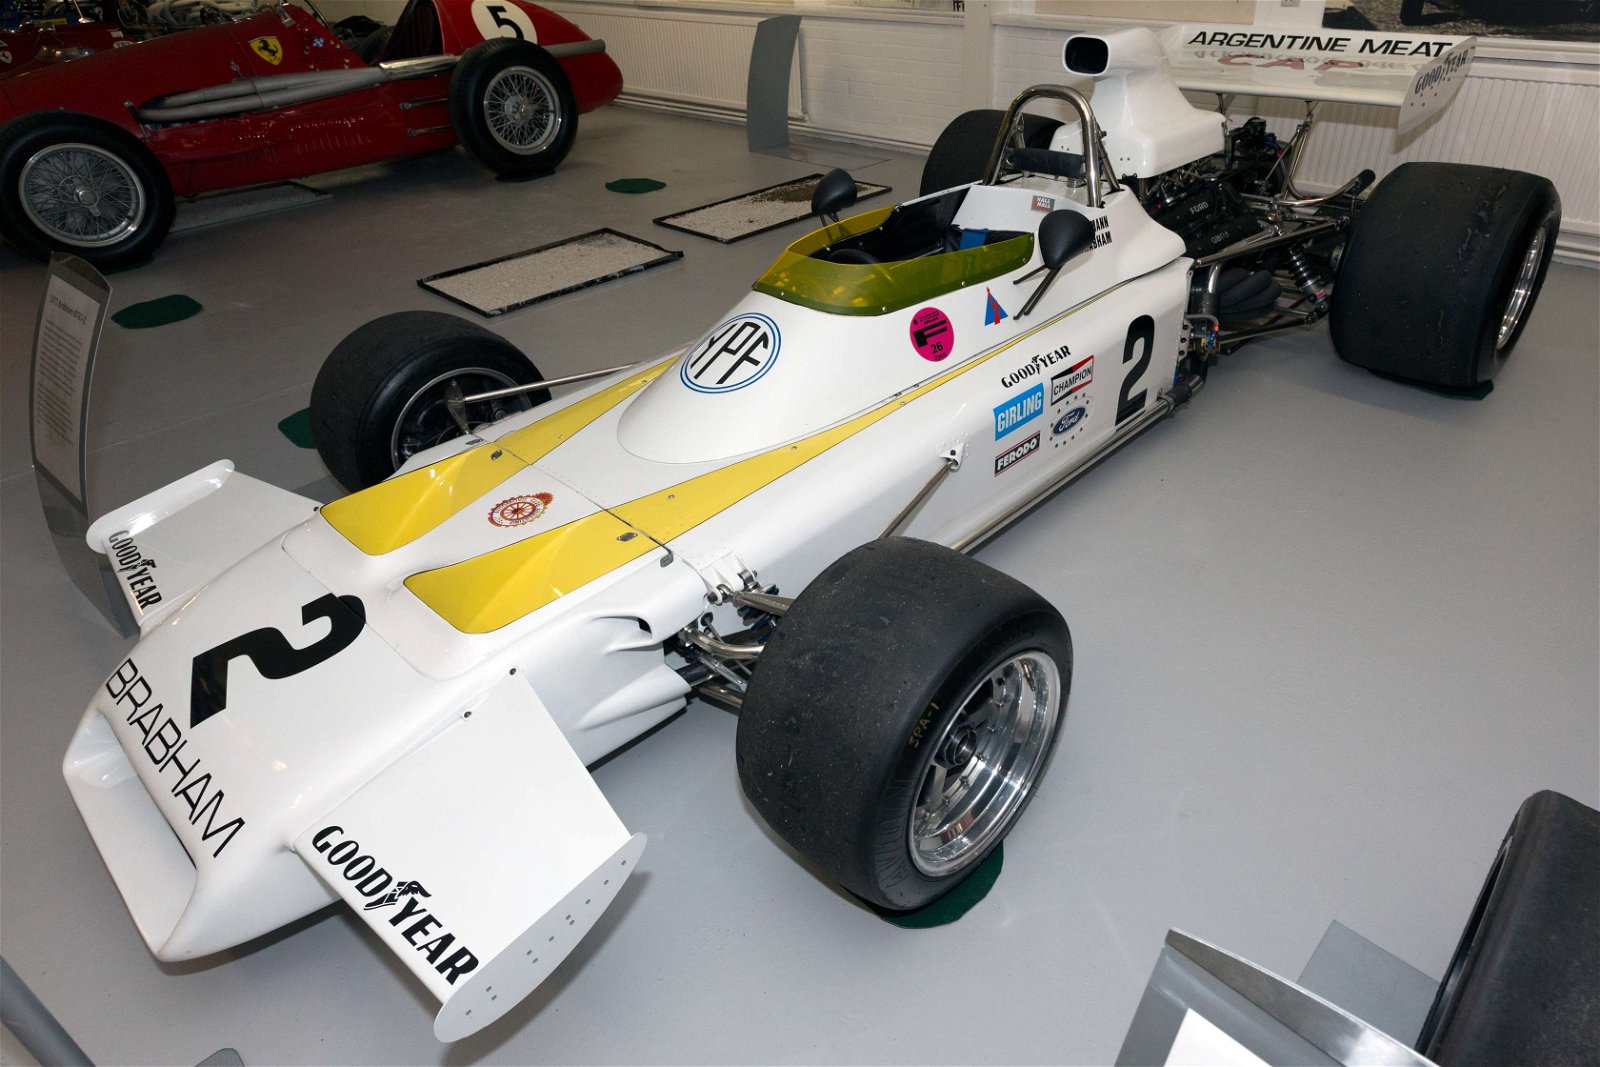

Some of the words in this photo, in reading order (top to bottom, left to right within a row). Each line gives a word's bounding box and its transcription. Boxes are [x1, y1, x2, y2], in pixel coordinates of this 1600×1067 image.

[485, 5, 525, 40] 5
[1187, 31, 1352, 52] ARGENTINE
[1358, 38, 1453, 58] MEAT
[1414, 49, 1469, 94] GOODYEAR
[1189, 201, 1209, 214] FORD
[690, 321, 769, 385] YPF
[930, 341, 944, 354] 26
[1001, 344, 1072, 388] GOODYEAR
[1053, 365, 1092, 396] CHAMPION
[1115, 314, 1155, 427] 2
[997, 391, 1042, 433] GIRLING
[997, 438, 1038, 471] FERODO
[108, 529, 163, 611] GOODYEAR
[190, 593, 366, 729] 2
[106, 658, 246, 858] BRABHAM
[311, 825, 479, 986] GOODYEAR
